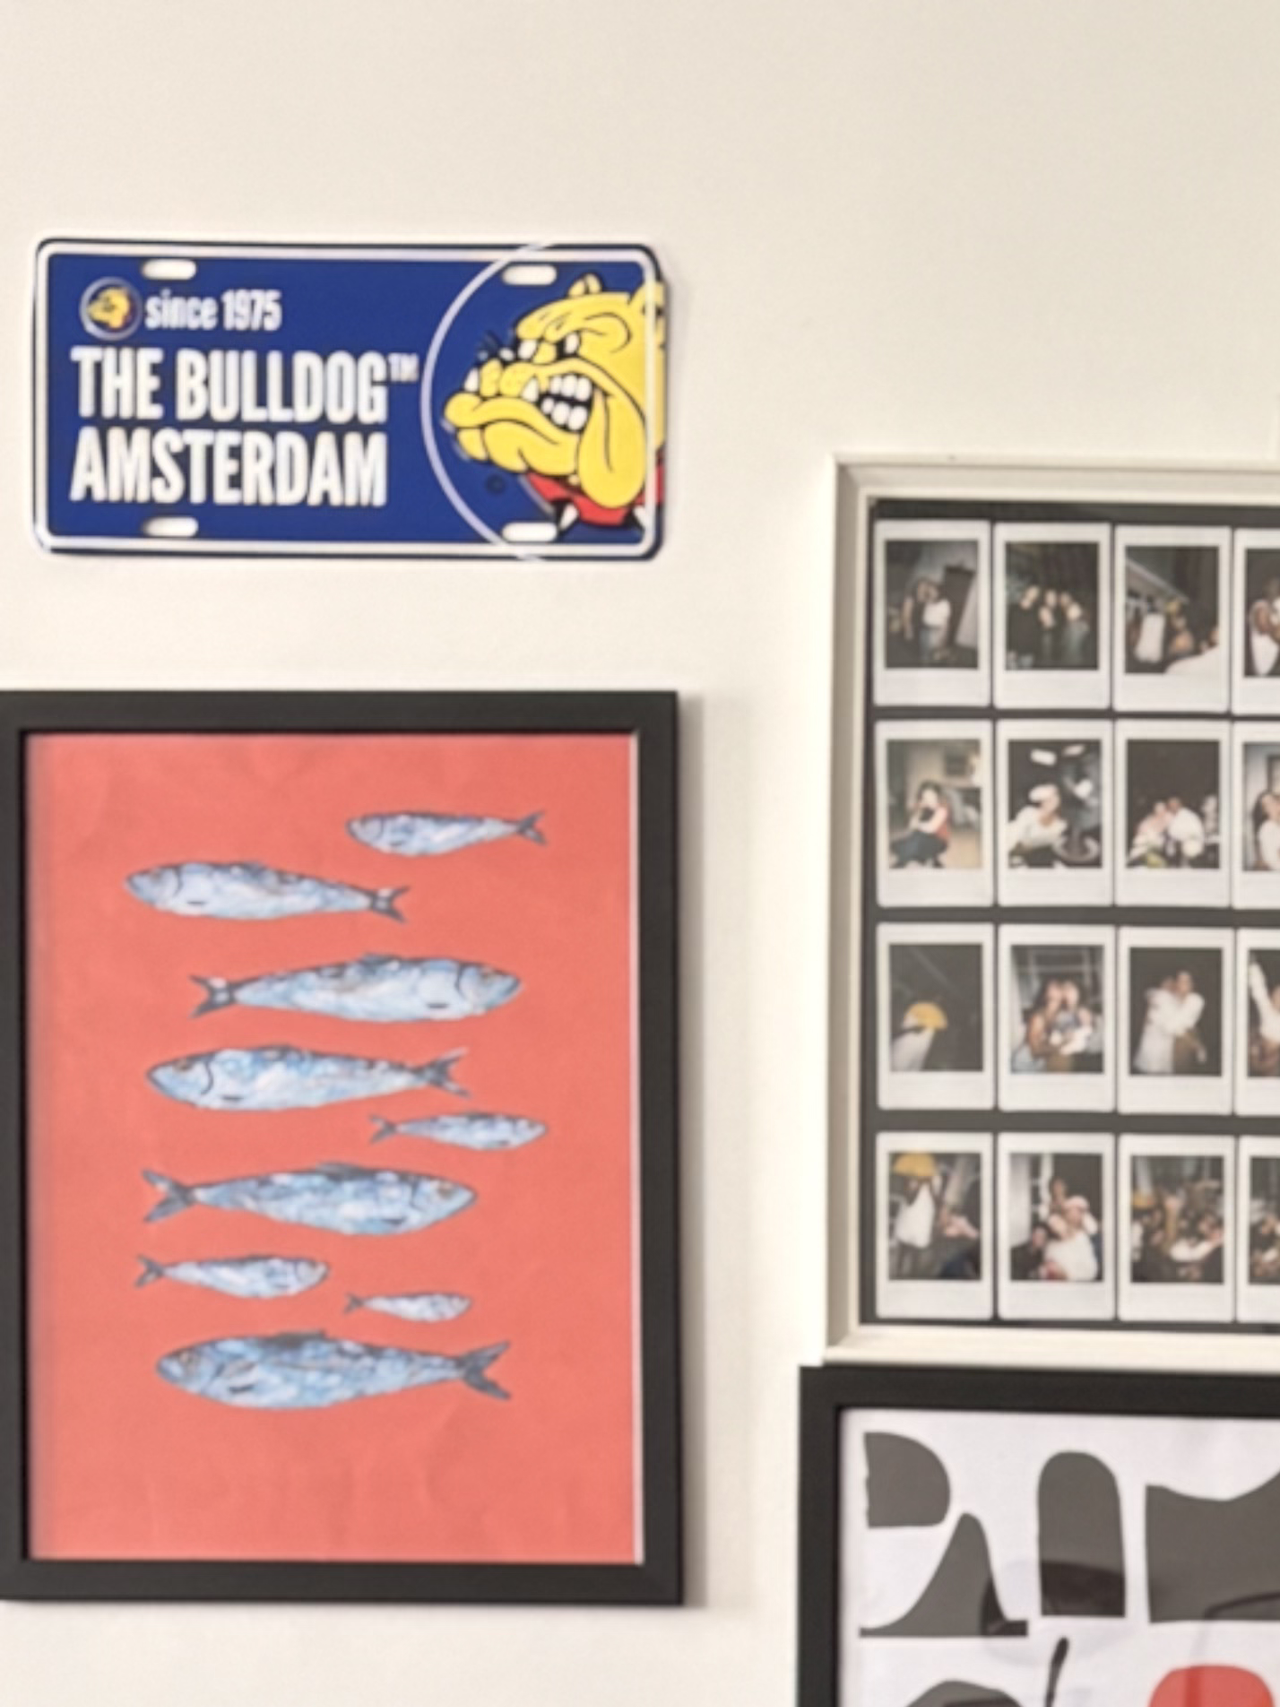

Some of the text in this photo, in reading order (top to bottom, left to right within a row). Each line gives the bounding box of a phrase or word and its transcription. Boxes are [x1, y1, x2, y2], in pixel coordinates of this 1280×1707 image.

[145, 289, 282, 331] since 1975
[70, 346, 164, 418] THE
[69, 426, 387, 507] AMSTERDAM
